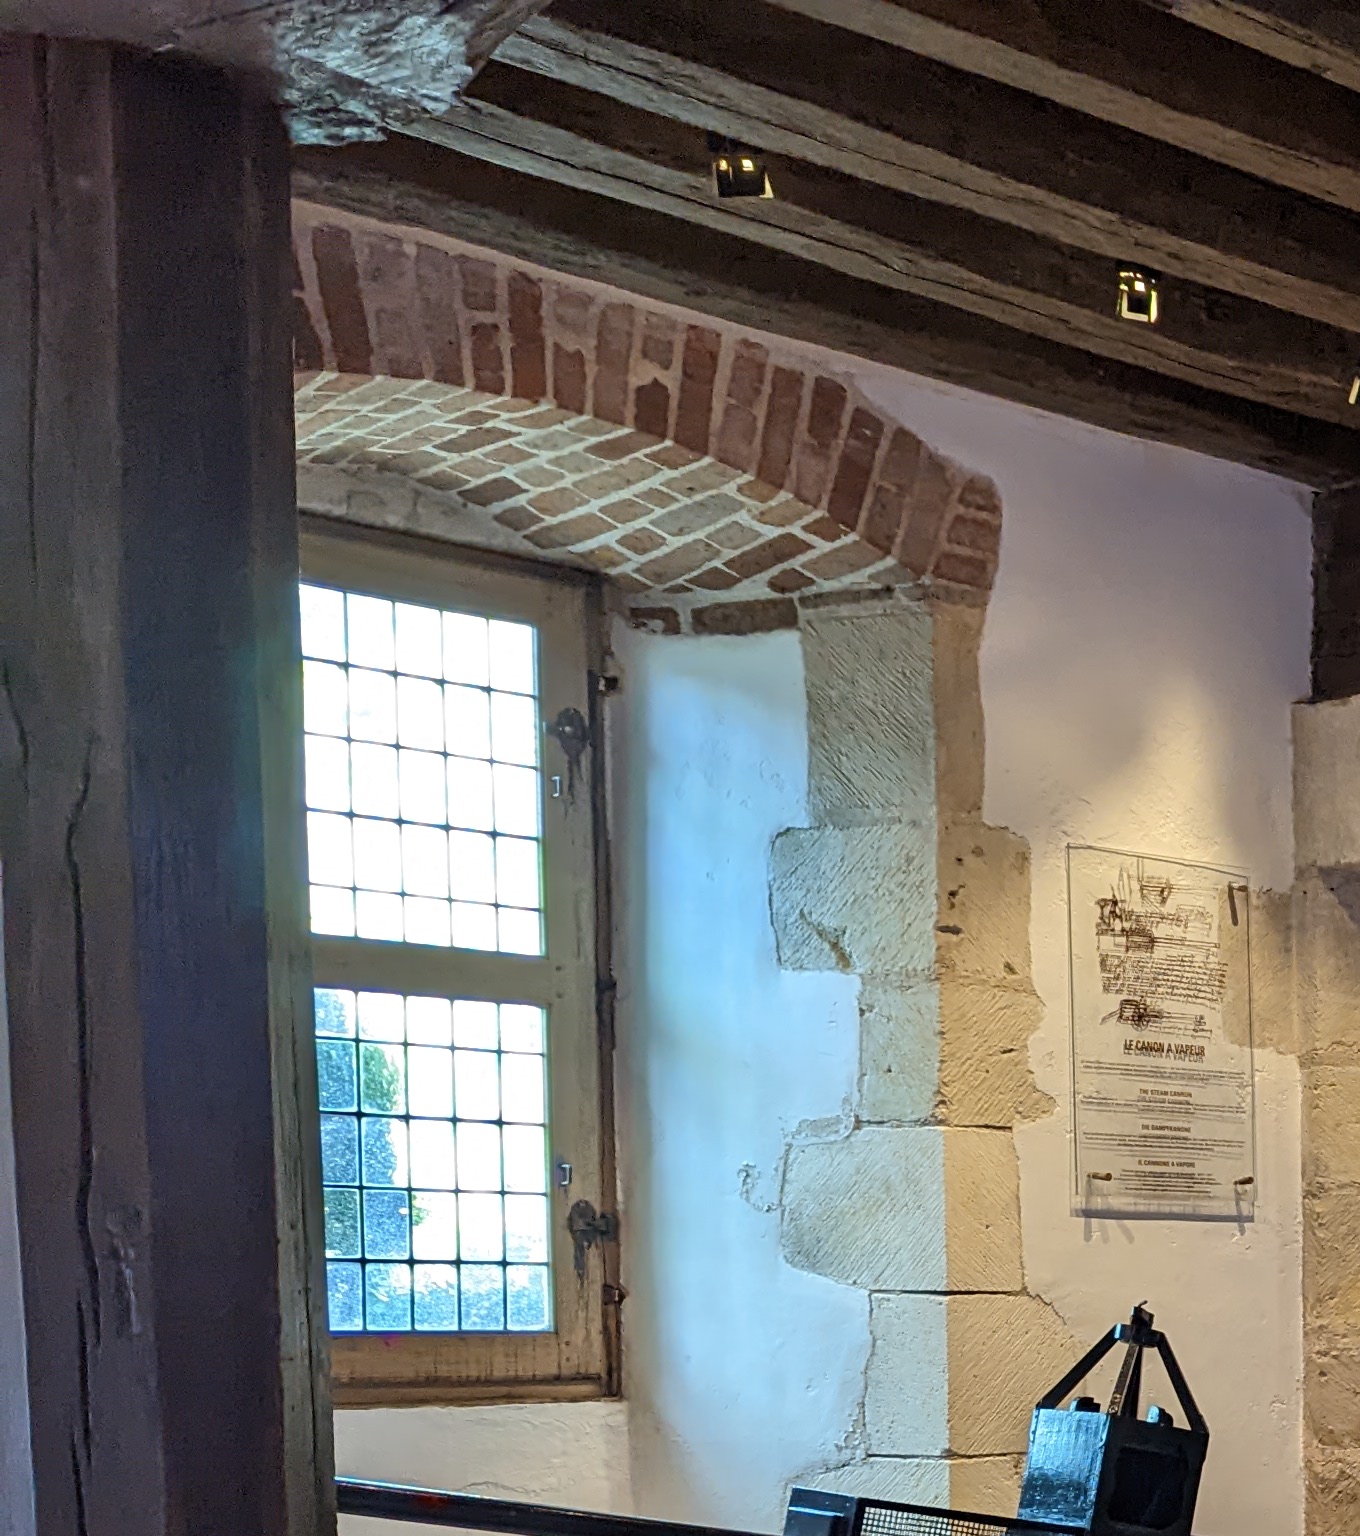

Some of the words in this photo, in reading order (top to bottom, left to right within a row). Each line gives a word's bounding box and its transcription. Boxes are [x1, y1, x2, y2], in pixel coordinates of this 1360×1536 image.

[1125, 1039, 1133, 1050] LE
[1136, 1040, 1164, 1053] CANON
[1174, 1043, 1205, 1056] VAPEUR
